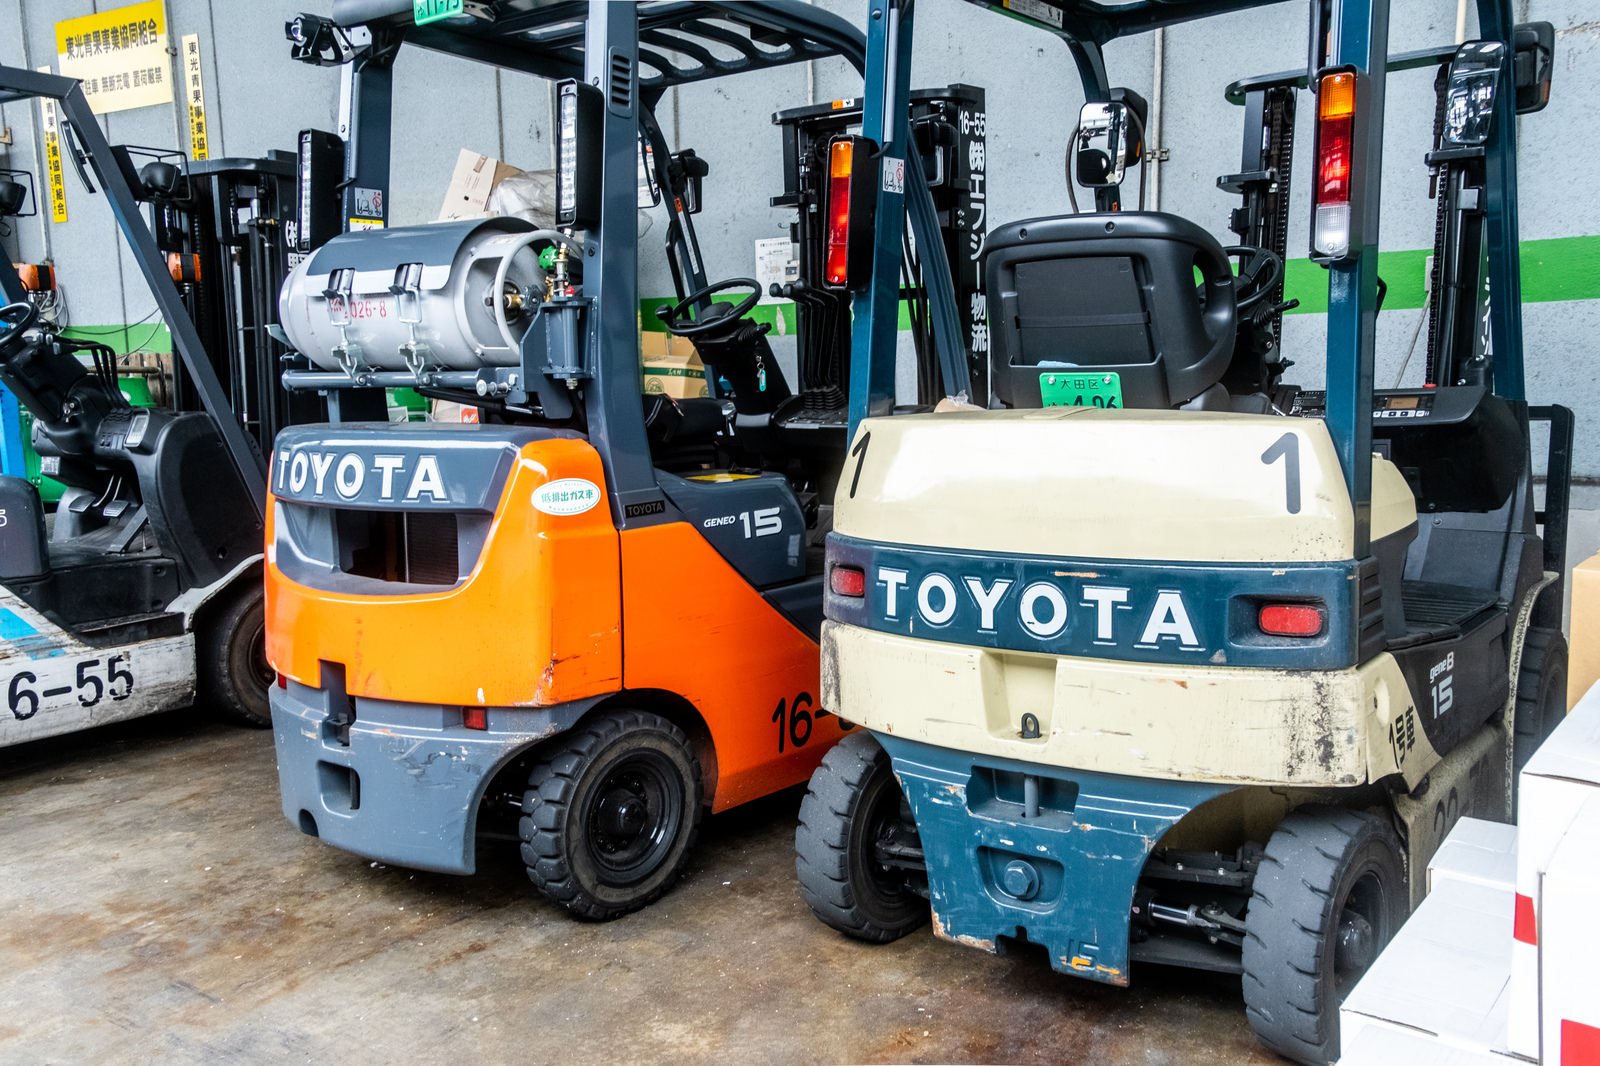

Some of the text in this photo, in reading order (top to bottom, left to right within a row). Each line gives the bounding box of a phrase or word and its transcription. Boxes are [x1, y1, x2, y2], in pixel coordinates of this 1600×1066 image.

[65, 18, 158, 61] 東光青果事業協同組合
[959, 111, 986, 137] 16-55
[46, 98, 65, 215] 青果事業協同組合
[1060, 377, 1100, 390] 大田区
[277, 449, 448, 503] TOYOTA
[848, 431, 871, 499] 1
[1260, 432, 1301, 514] 1
[541, 488, 595, 504] 低排出ガス車
[627, 502, 664, 517] TOYOTA
[703, 506, 783, 539] GENEO 15
[877, 567, 1202, 648] TOYOTA
[1431, 674, 1454, 720] 15
[772, 691, 857, 754] 16-
